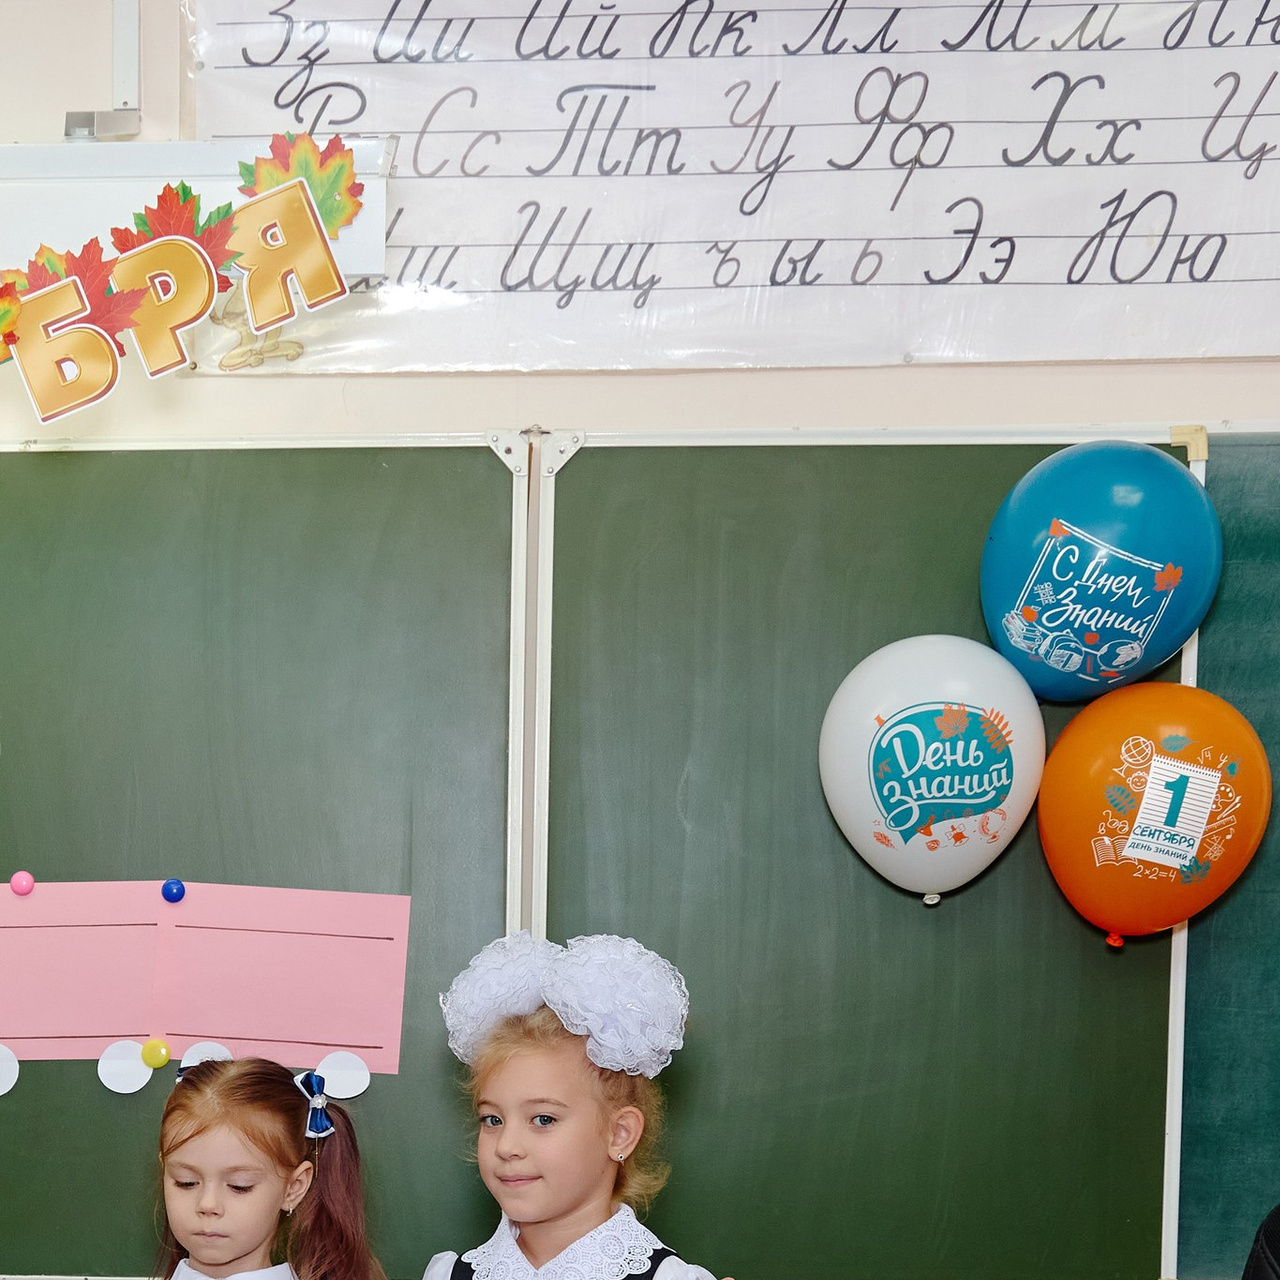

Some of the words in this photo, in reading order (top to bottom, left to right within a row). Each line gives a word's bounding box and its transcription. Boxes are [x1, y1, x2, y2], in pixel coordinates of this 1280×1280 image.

[1052, 545, 1079, 581] С
[1074, 549, 1151, 608] Днем
[1041, 587, 1154, 639] Знаний
[880, 723, 984, 778] День
[1164, 773, 1190, 829] 1
[1128, 841, 1152, 852] ДЕНЬ
[1153, 846, 1188, 861] ЗНАНИЙ
[1132, 824, 1196, 850] СЕНТЯБРЯ
